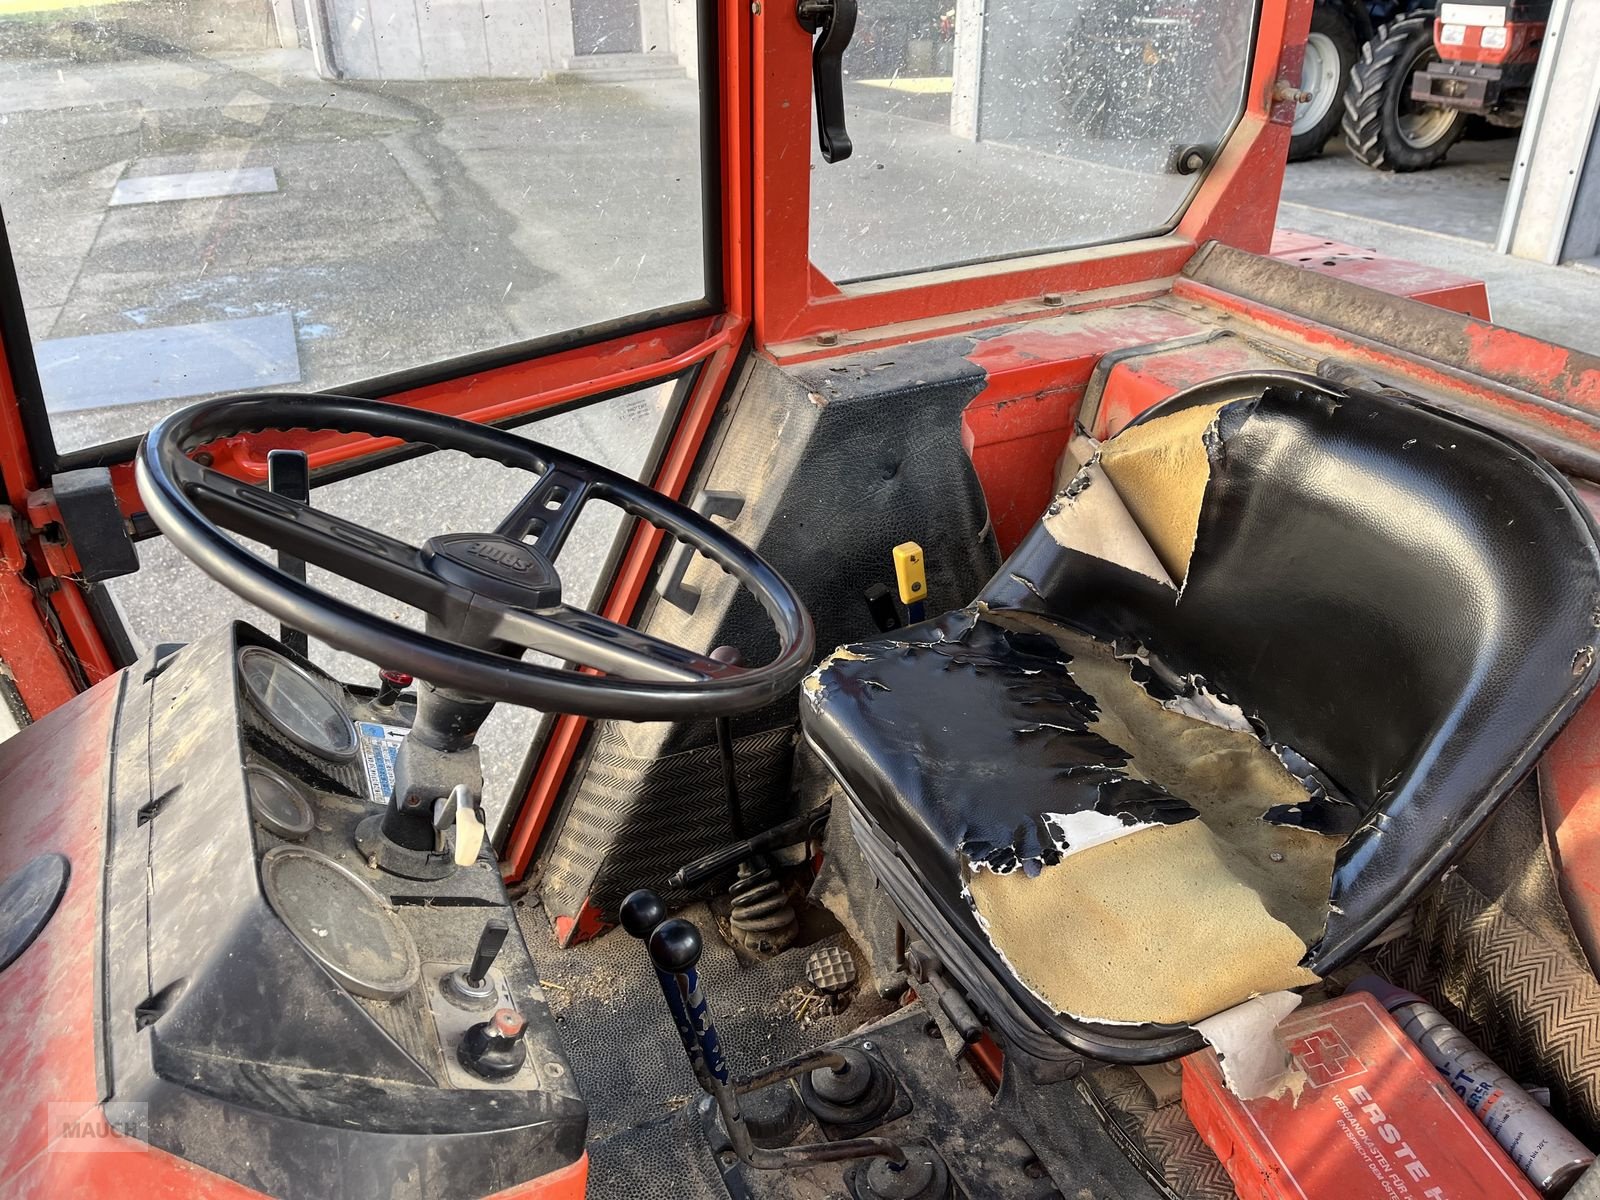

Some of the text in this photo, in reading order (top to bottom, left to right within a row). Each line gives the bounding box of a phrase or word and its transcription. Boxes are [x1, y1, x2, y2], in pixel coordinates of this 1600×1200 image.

[1332, 1094, 1408, 1194] VERBANDKASTEN FÜR
[1336, 1119, 1373, 1162] ENTSPRICHT
[1368, 1162, 1385, 1181] DEM
[1347, 1084, 1431, 1182] ERSTE
